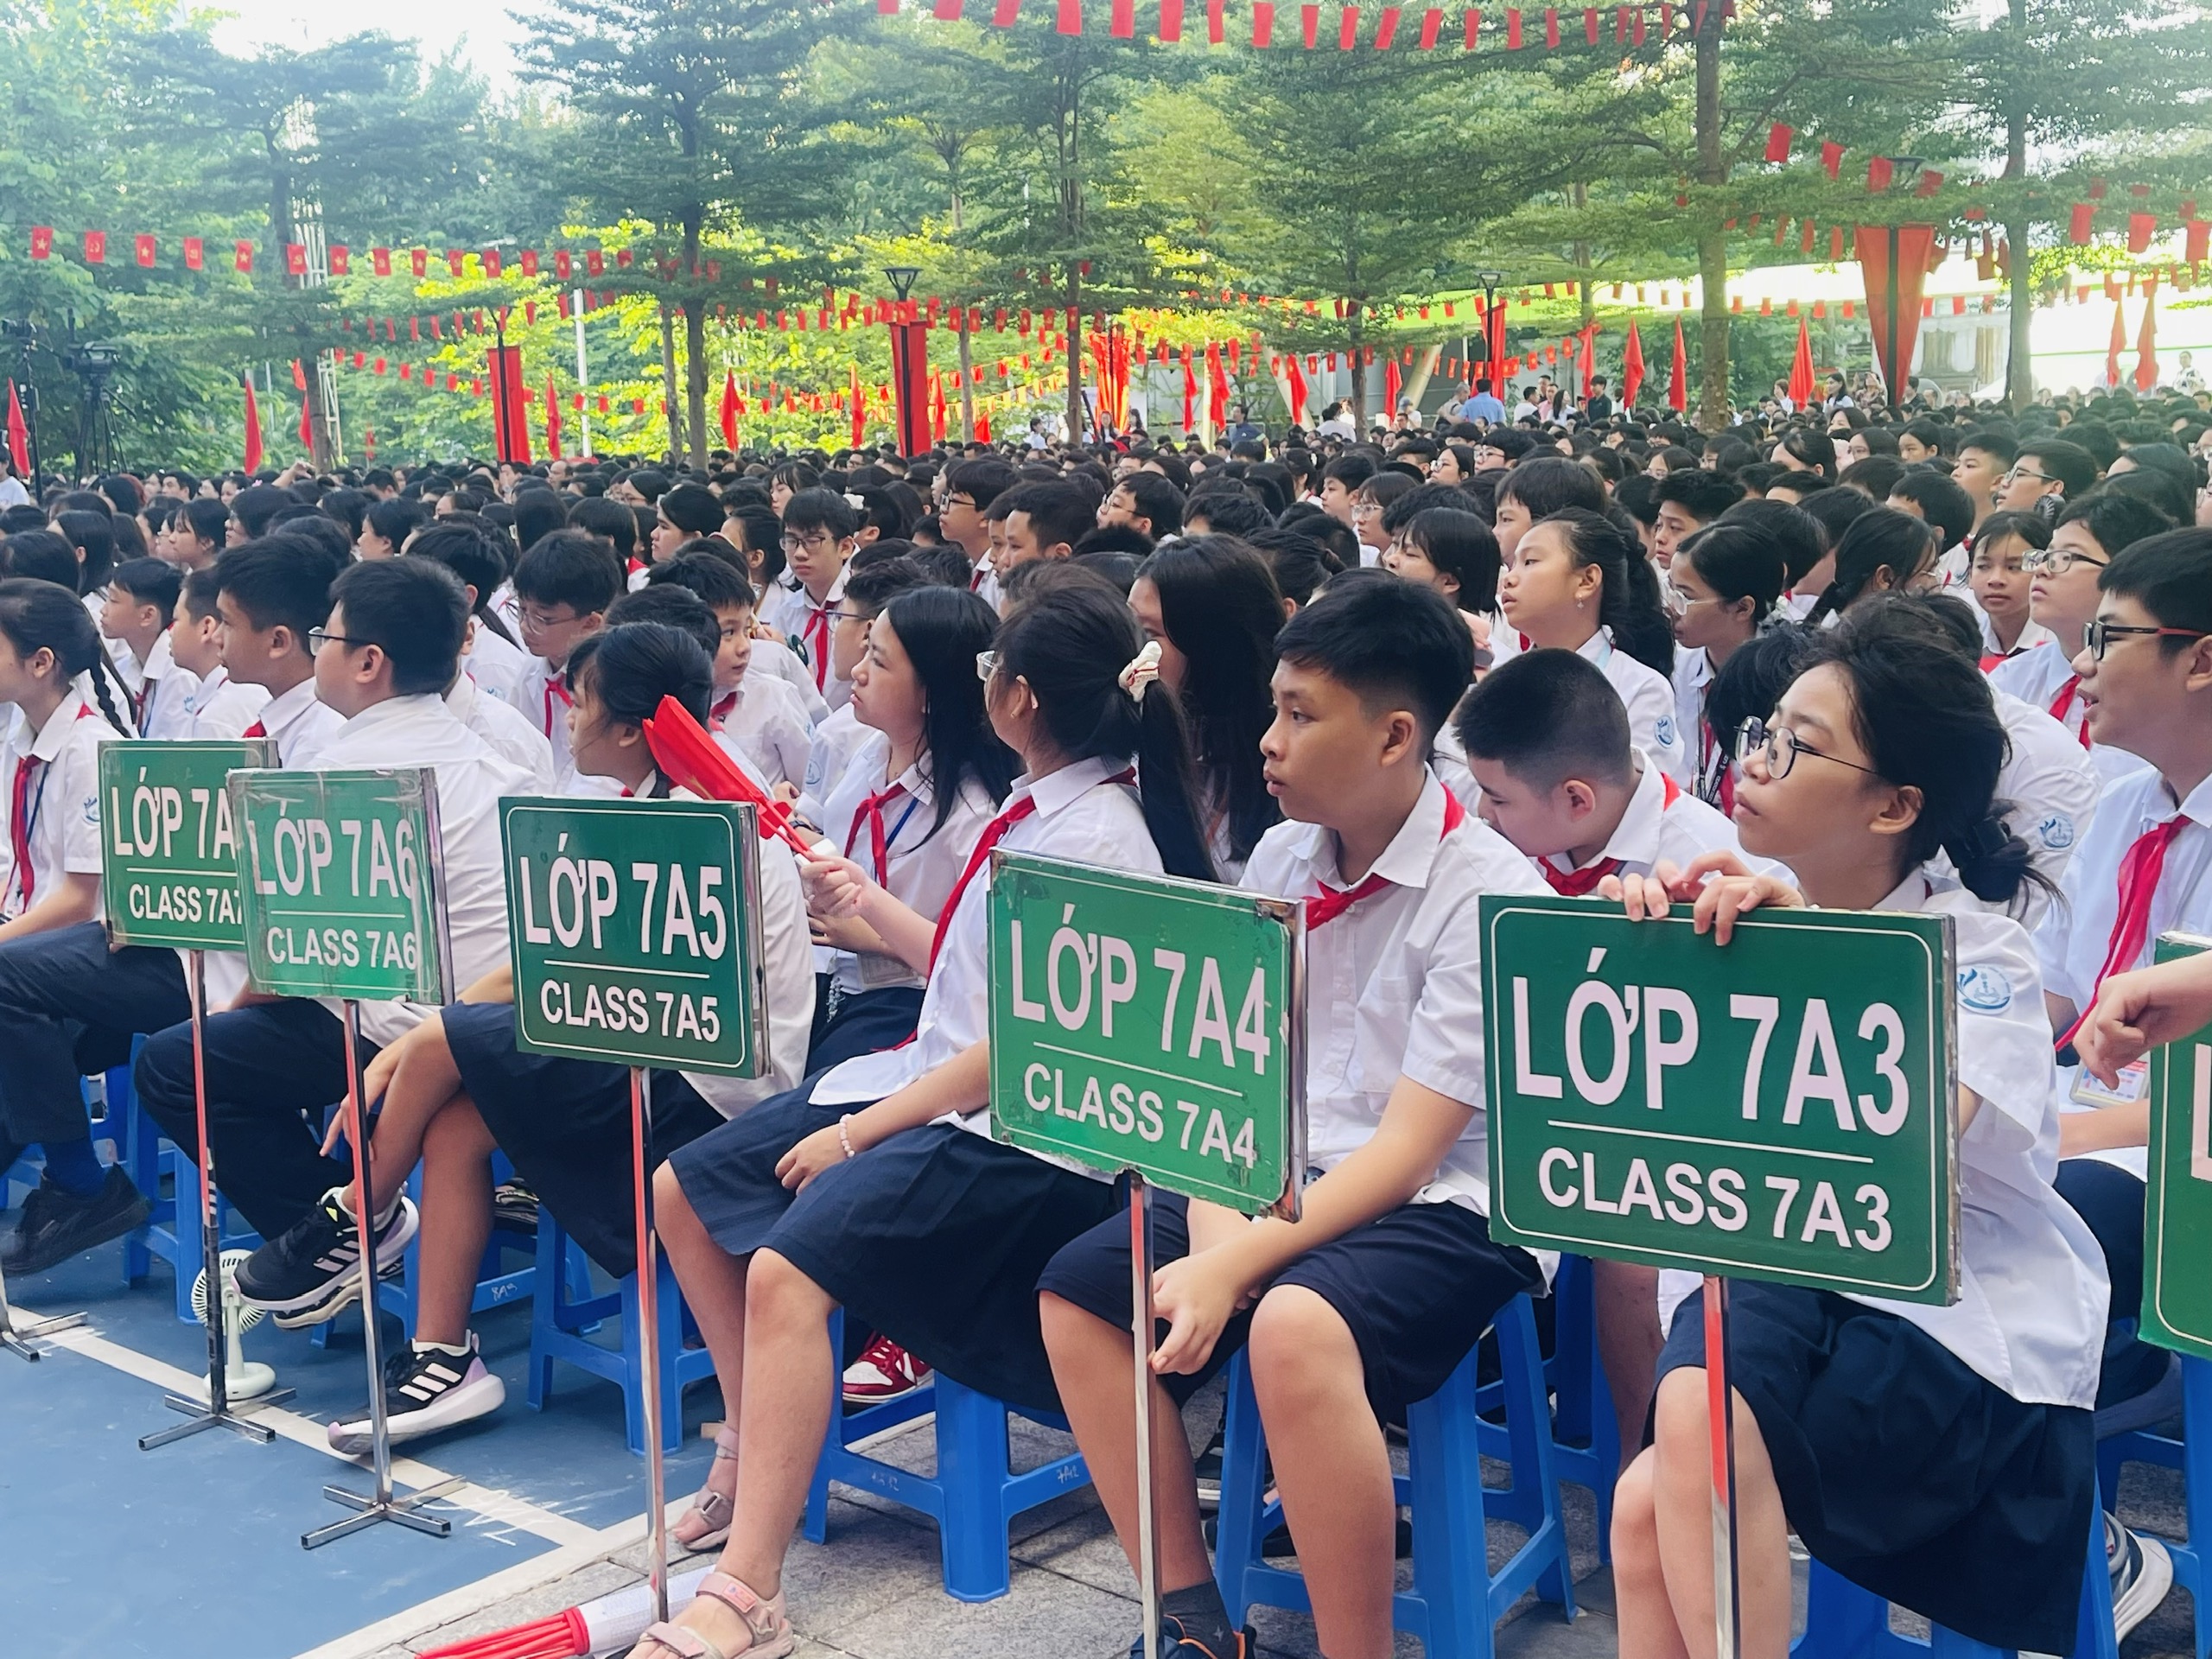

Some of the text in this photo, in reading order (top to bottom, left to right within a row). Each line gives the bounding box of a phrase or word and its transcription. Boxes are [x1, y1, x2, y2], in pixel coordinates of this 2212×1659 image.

[111, 766, 237, 860] LỚP 7A
[246, 799, 417, 899] LỚP 7A6
[129, 883, 202, 923] CLASS
[520, 832, 727, 960] LỚP 7A5
[267, 926, 417, 969] CLASS 7A6
[1011, 903, 1270, 1076] LỚP 7A4
[541, 979, 720, 1042] CLASS 7A5
[1513, 947, 1910, 1136] LỚP 7A3
[1024, 1063, 1255, 1169] CLASS 7A4
[1538, 1147, 1892, 1252] CLASS 7A3
